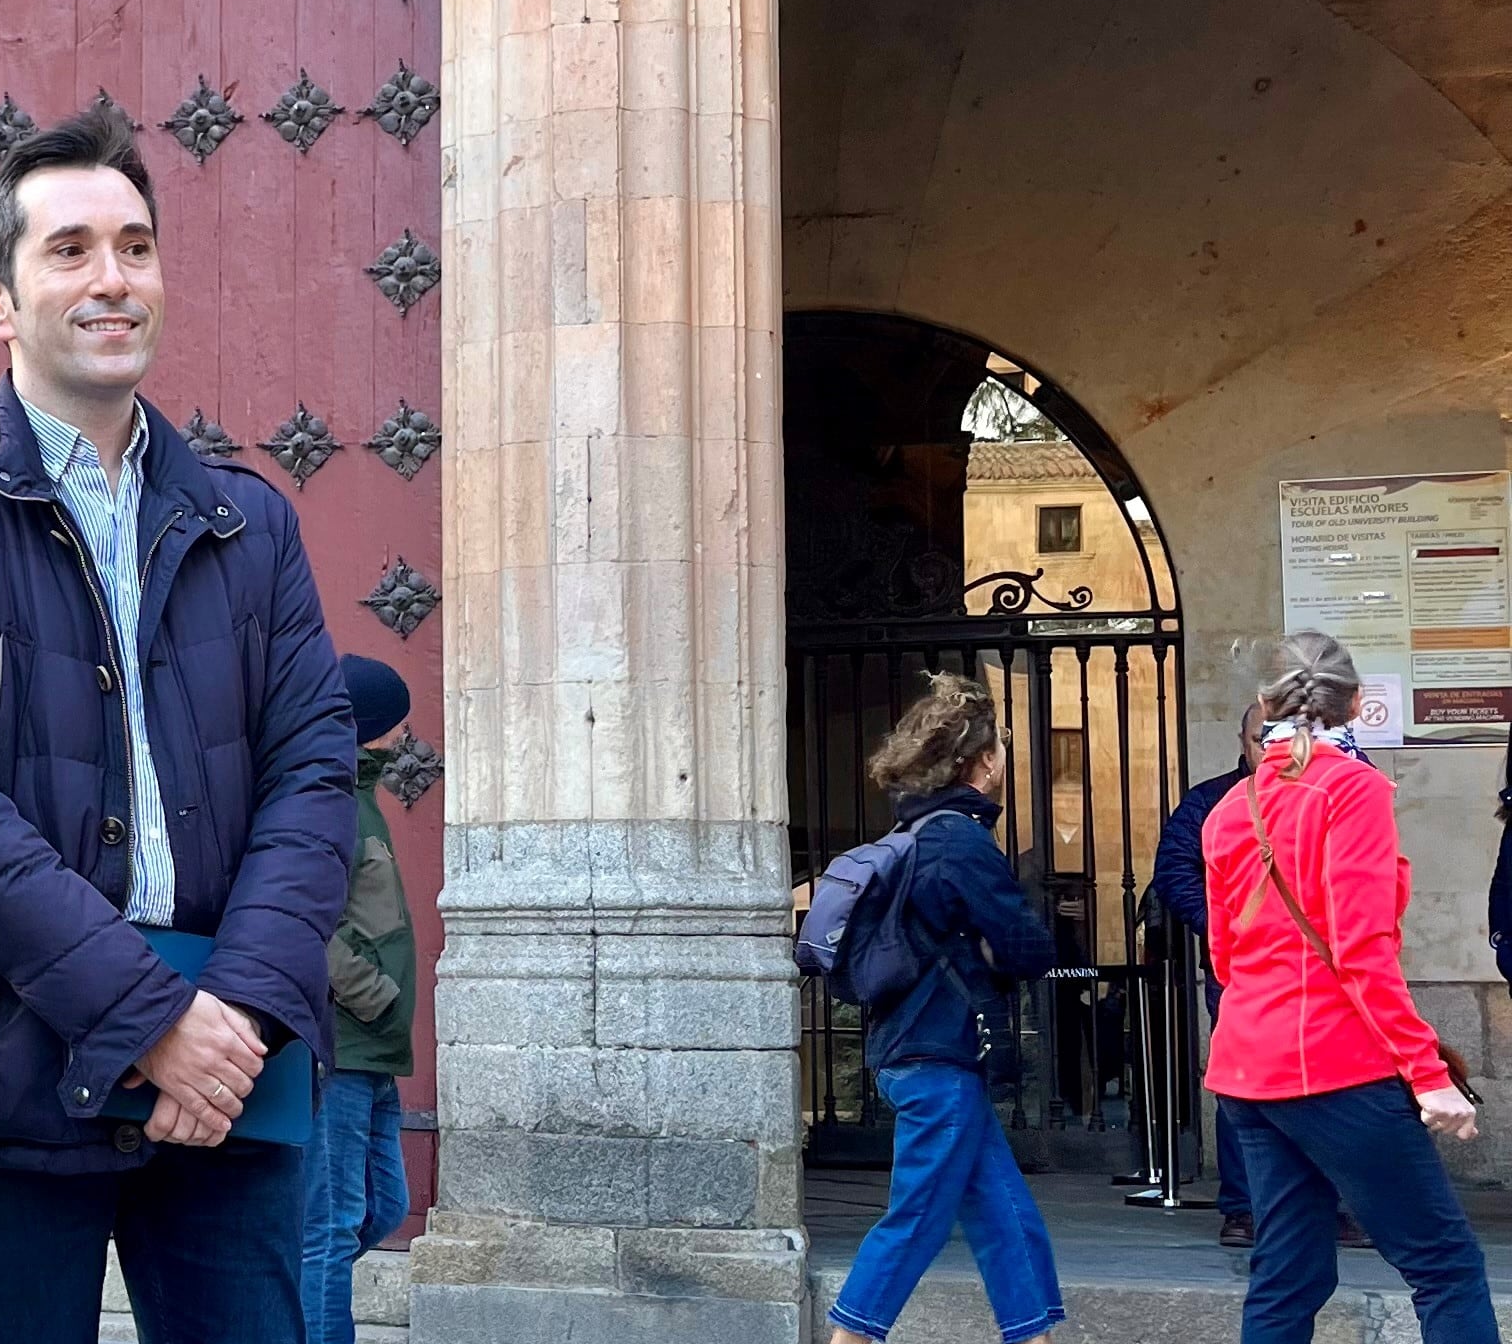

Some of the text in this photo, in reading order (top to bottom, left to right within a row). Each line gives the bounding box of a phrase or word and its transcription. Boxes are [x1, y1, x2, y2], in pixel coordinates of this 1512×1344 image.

[1290, 494, 1380, 507] VISITA EDIFICIO
[1290, 503, 1409, 517] ESCUELAS MAYORES
[1292, 520, 1314, 528] TOUR
[1315, 518, 1327, 527] OF
[1348, 516, 1396, 526] UNIVERSITY
[1398, 514, 1440, 524] BUILDING
[1291, 532, 1386, 544] HORARIO DE VISITAS
